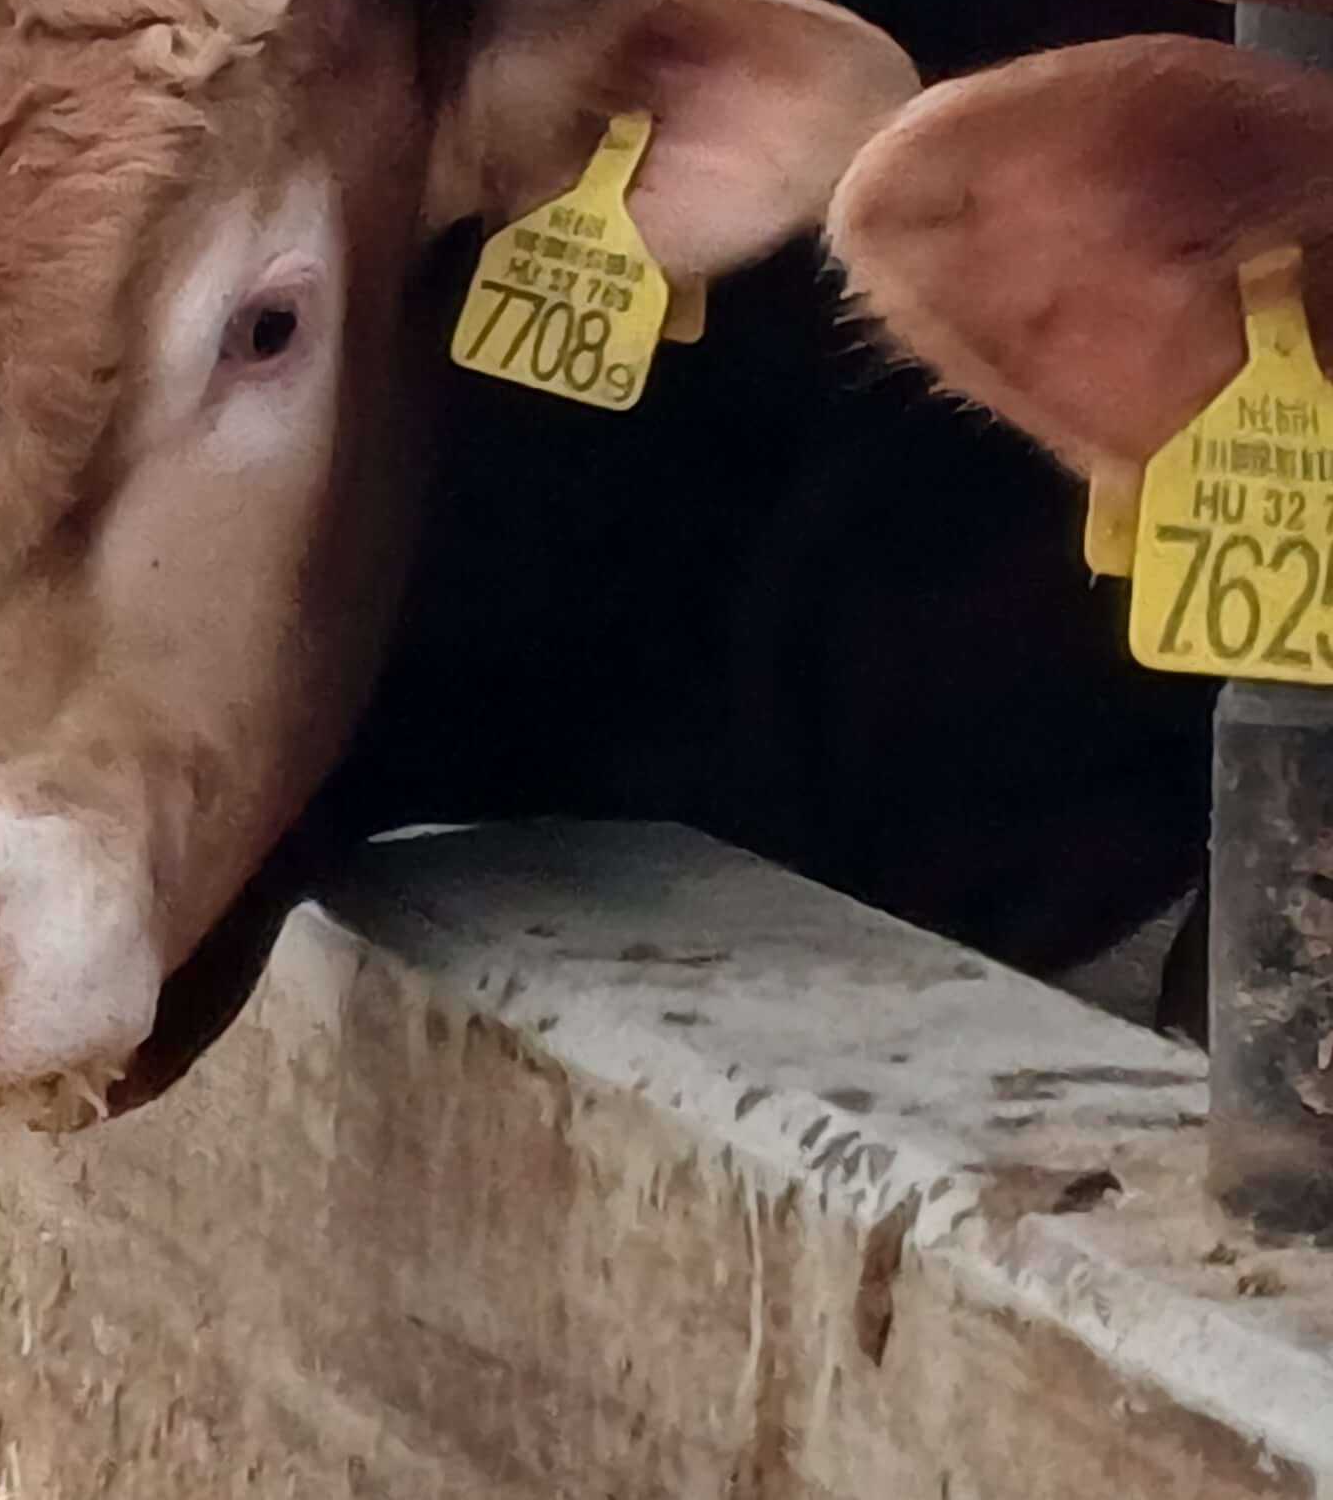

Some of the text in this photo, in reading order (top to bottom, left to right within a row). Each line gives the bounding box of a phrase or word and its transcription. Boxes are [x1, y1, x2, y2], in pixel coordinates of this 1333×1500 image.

[465, 279, 612, 392] 7708
[1192, 479, 1248, 525] HU
[1263, 488, 1307, 532] 32
